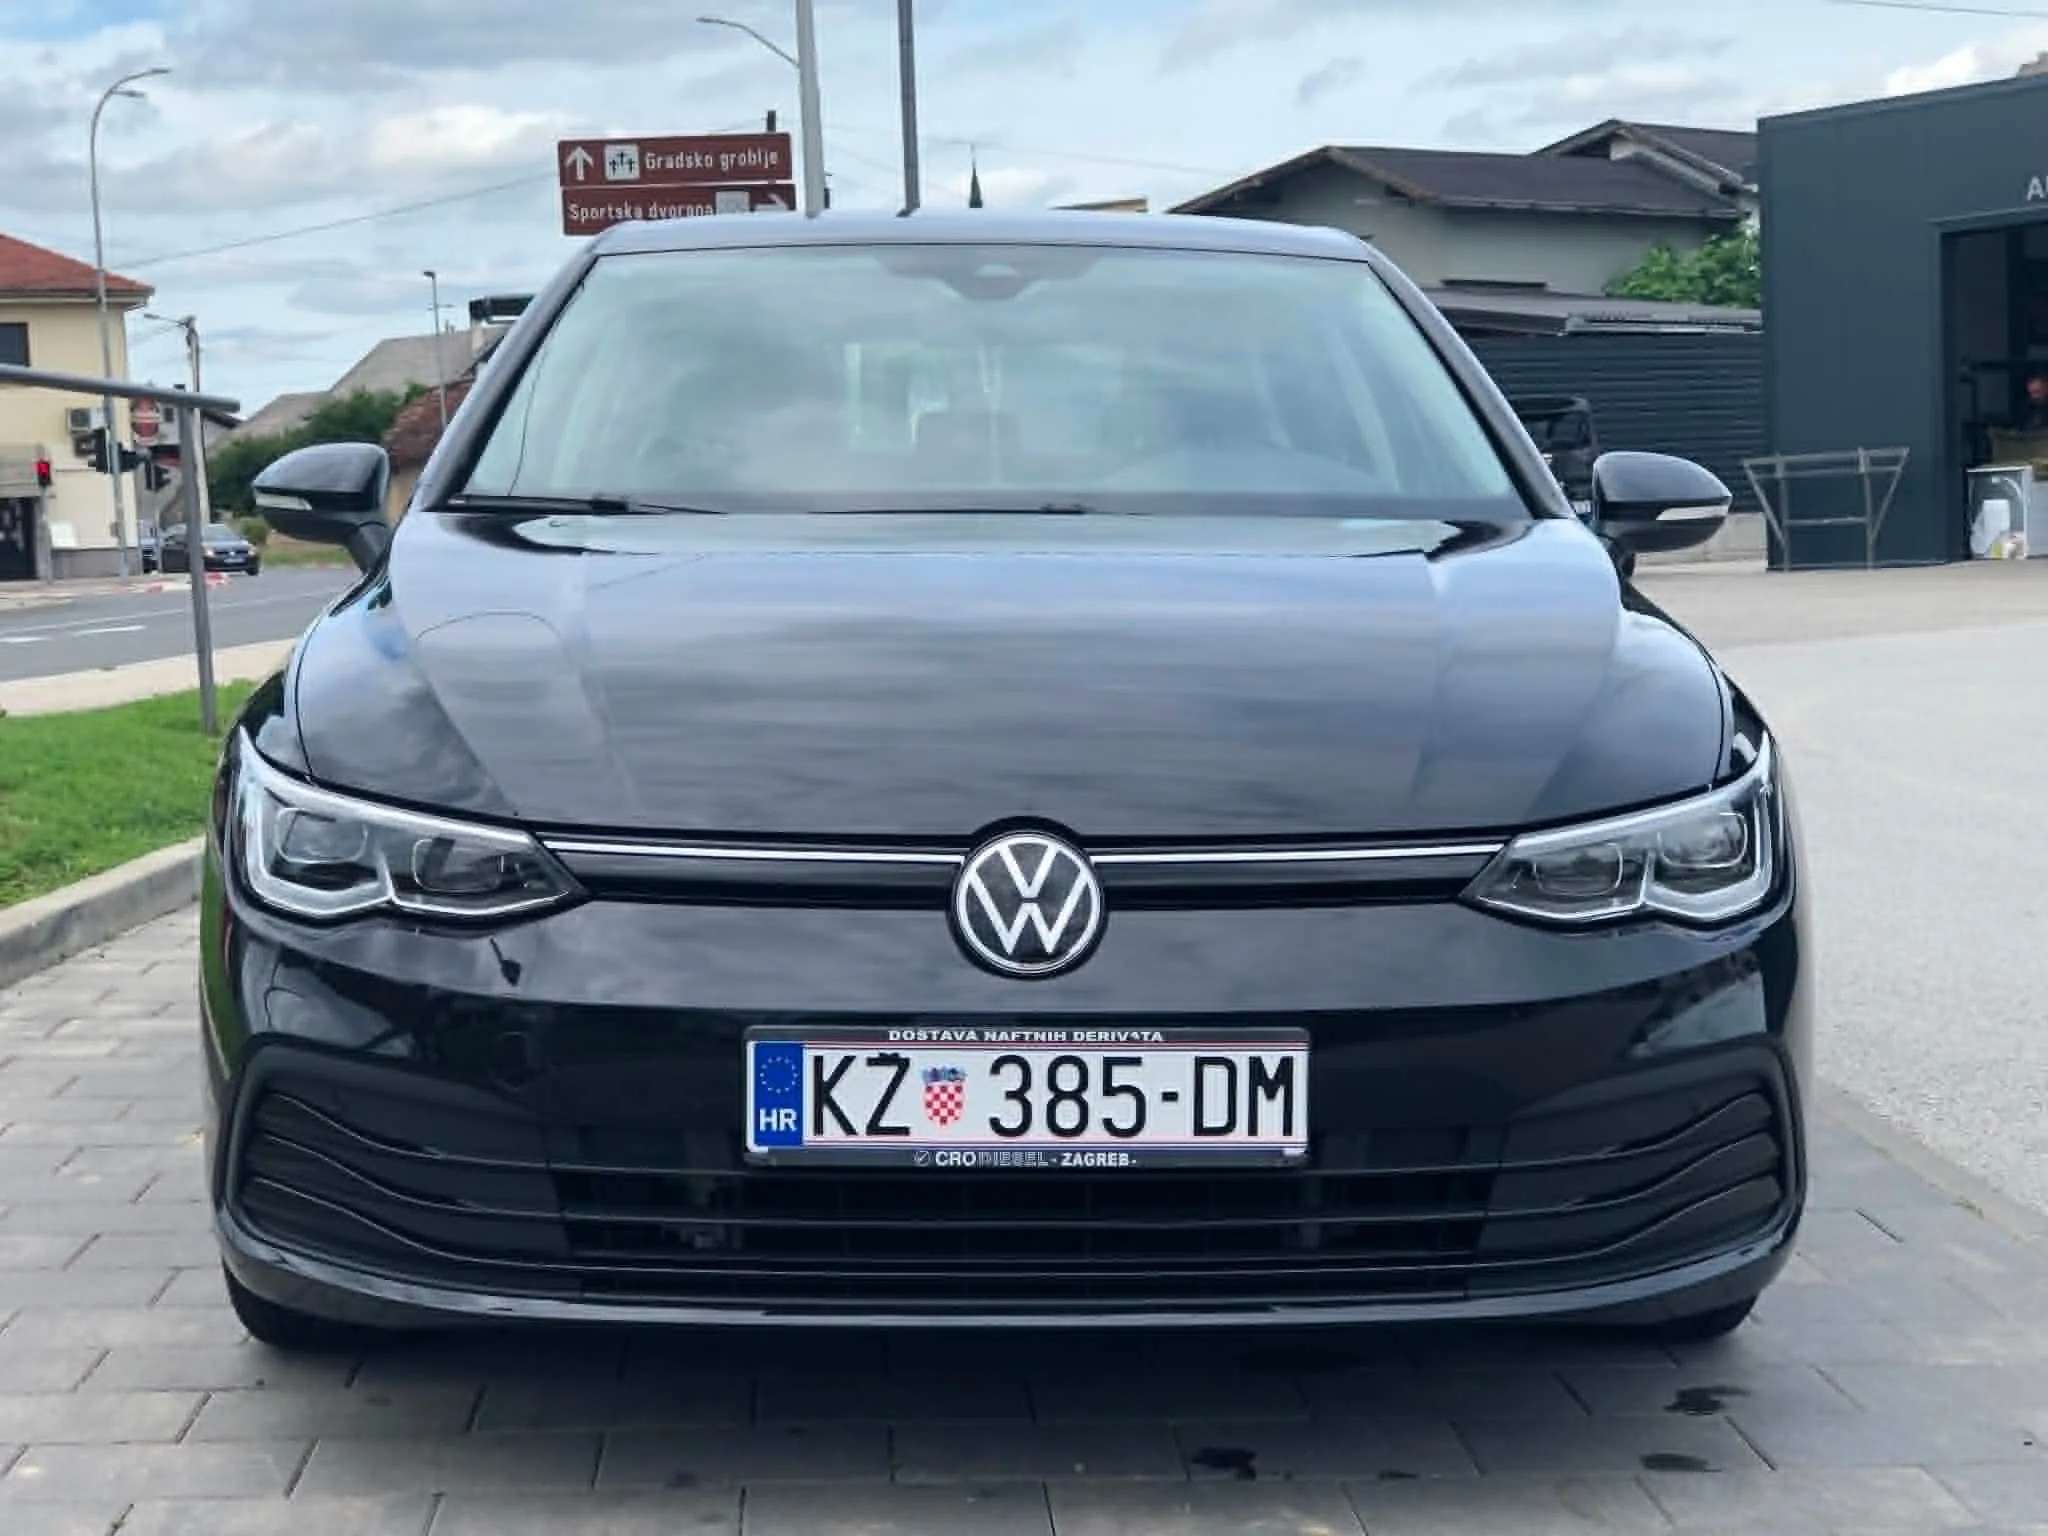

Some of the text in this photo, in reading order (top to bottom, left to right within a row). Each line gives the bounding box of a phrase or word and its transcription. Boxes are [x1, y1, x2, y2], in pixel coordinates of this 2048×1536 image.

[645, 147, 778, 170] Gradsko groblje
[2026, 175, 2048, 201] A
[888, 1030, 978, 1041] DOSTAVA
[984, 1031, 1066, 1042] NAFTNIH
[813, 1053, 1293, 1137] KŽ 385-DM
[759, 1108, 797, 1131] HR
